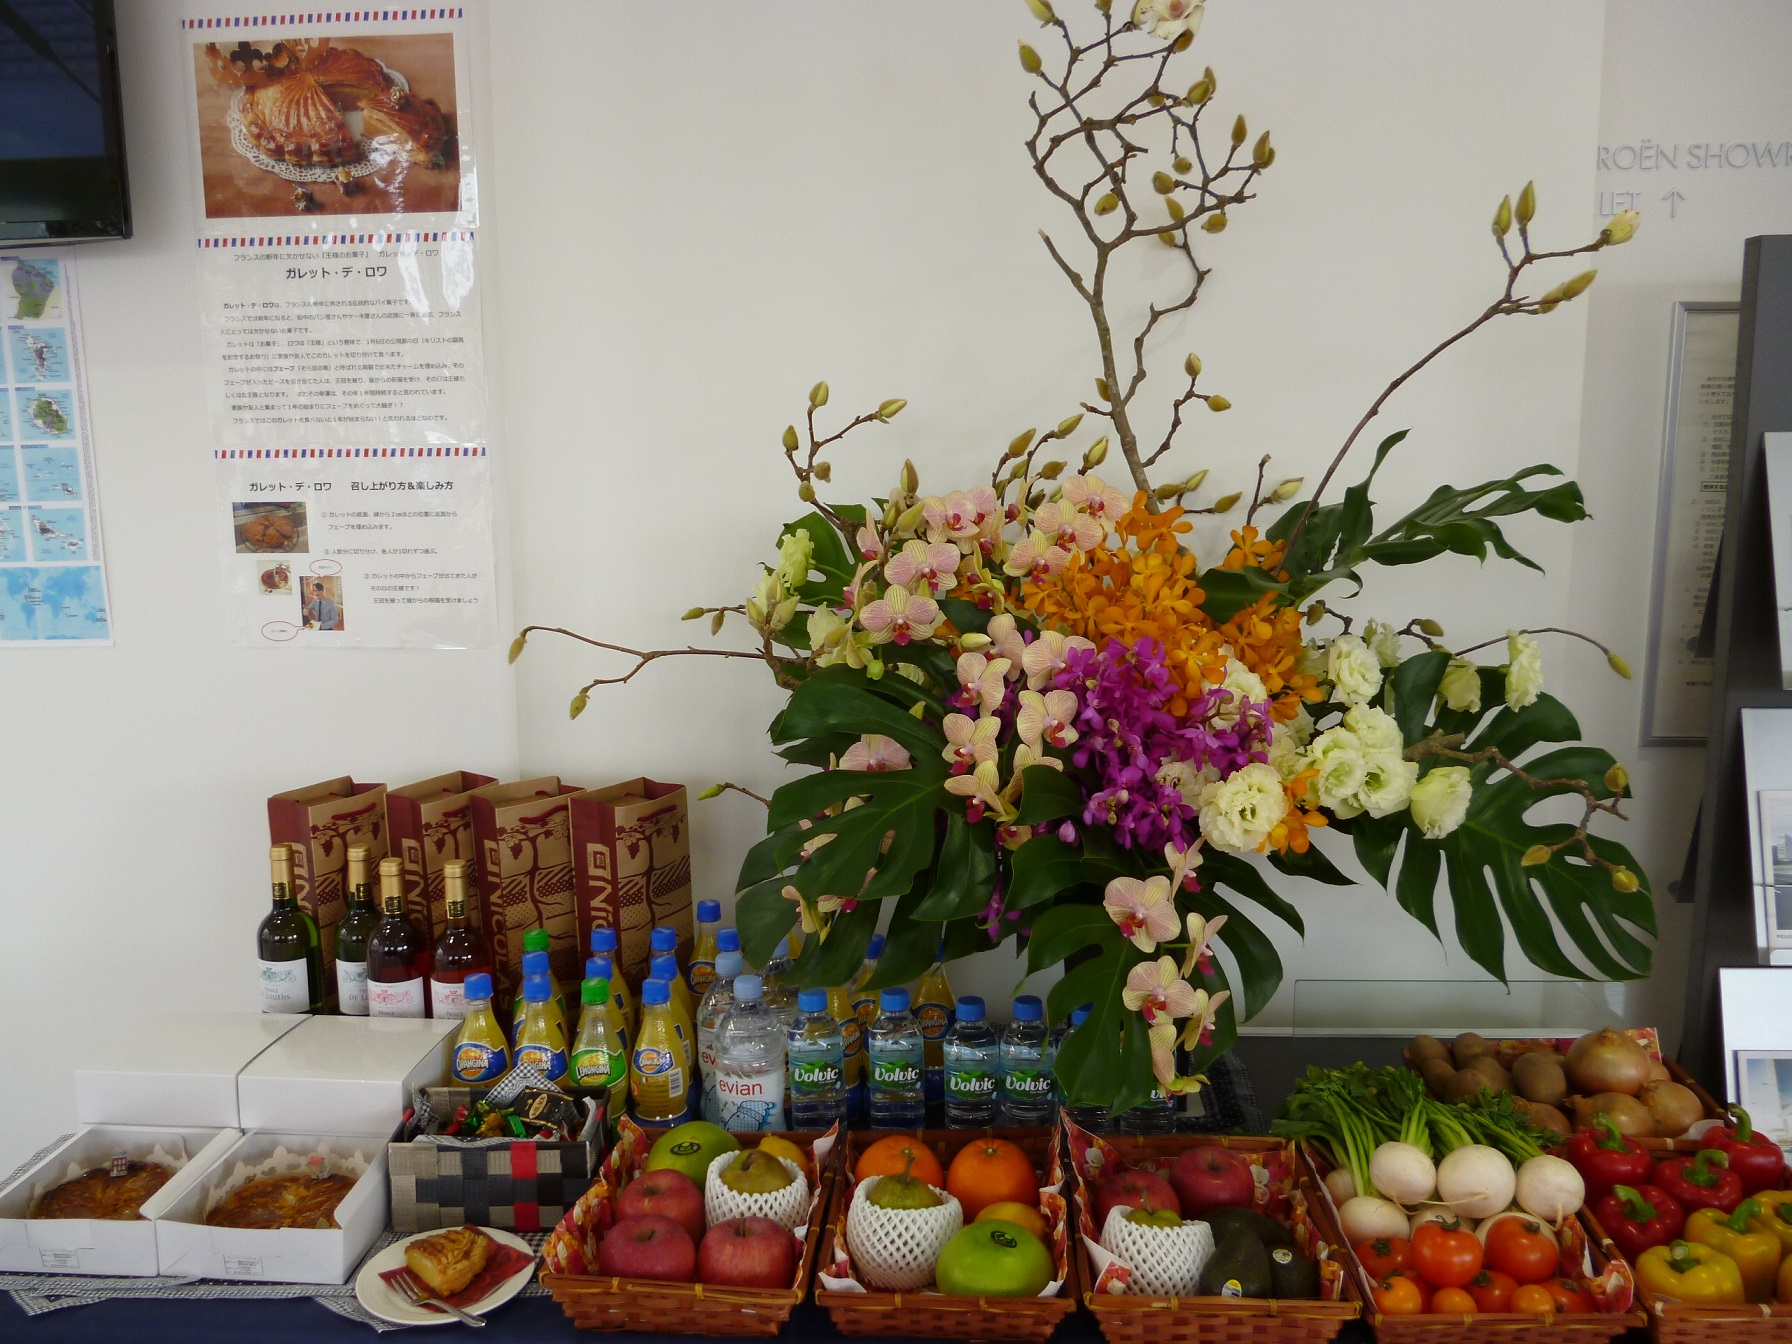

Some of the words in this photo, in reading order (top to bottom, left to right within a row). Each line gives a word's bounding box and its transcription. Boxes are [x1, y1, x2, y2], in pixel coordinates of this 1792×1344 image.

[1597, 138, 1680, 170] ROËN
[1600, 191, 1641, 215] LET
[286, 266, 388, 280] ガレット・デ・ロワ
[249, 482, 332, 492] ガレット・デ・ロワ
[350, 480, 454, 493] 召し上がり方＆楽しみ方
[455, 1057, 490, 1069] ORANGINA
[794, 1067, 839, 1083] Volvic
[874, 1067, 920, 1083] Volvic
[719, 1078, 763, 1096] evian
[950, 1075, 996, 1092] Volvic
[1005, 1075, 1051, 1092] Volvic
